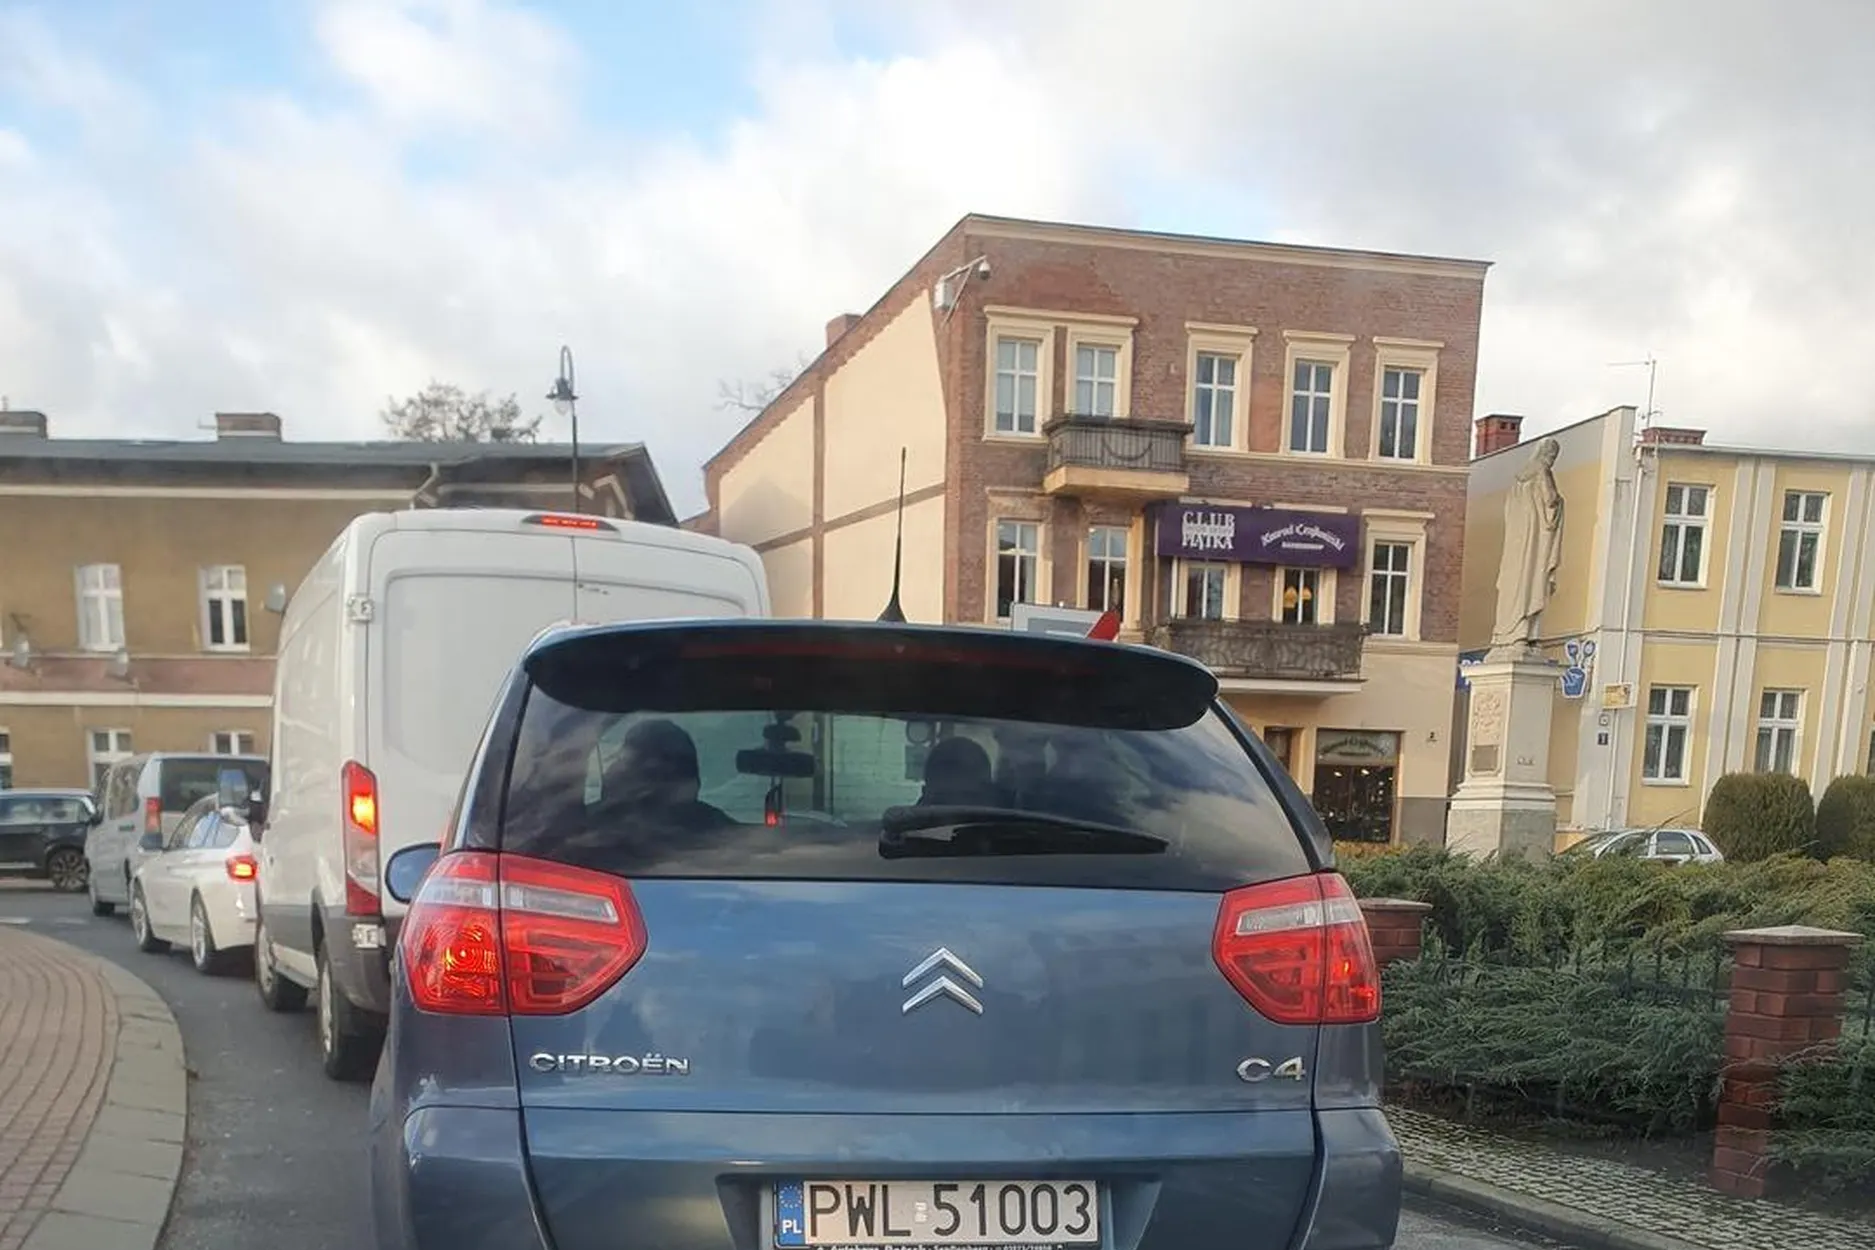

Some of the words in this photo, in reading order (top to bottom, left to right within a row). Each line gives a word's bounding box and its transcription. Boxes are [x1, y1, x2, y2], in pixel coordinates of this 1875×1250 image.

[1182, 511, 1235, 527] CLUB
[529, 1053, 690, 1075] CITROËN
[1236, 1056, 1306, 1082] C4
[809, 1183, 912, 1237] PWL
[933, 1183, 1091, 1237] 51003
[782, 1219, 802, 1234] PL
